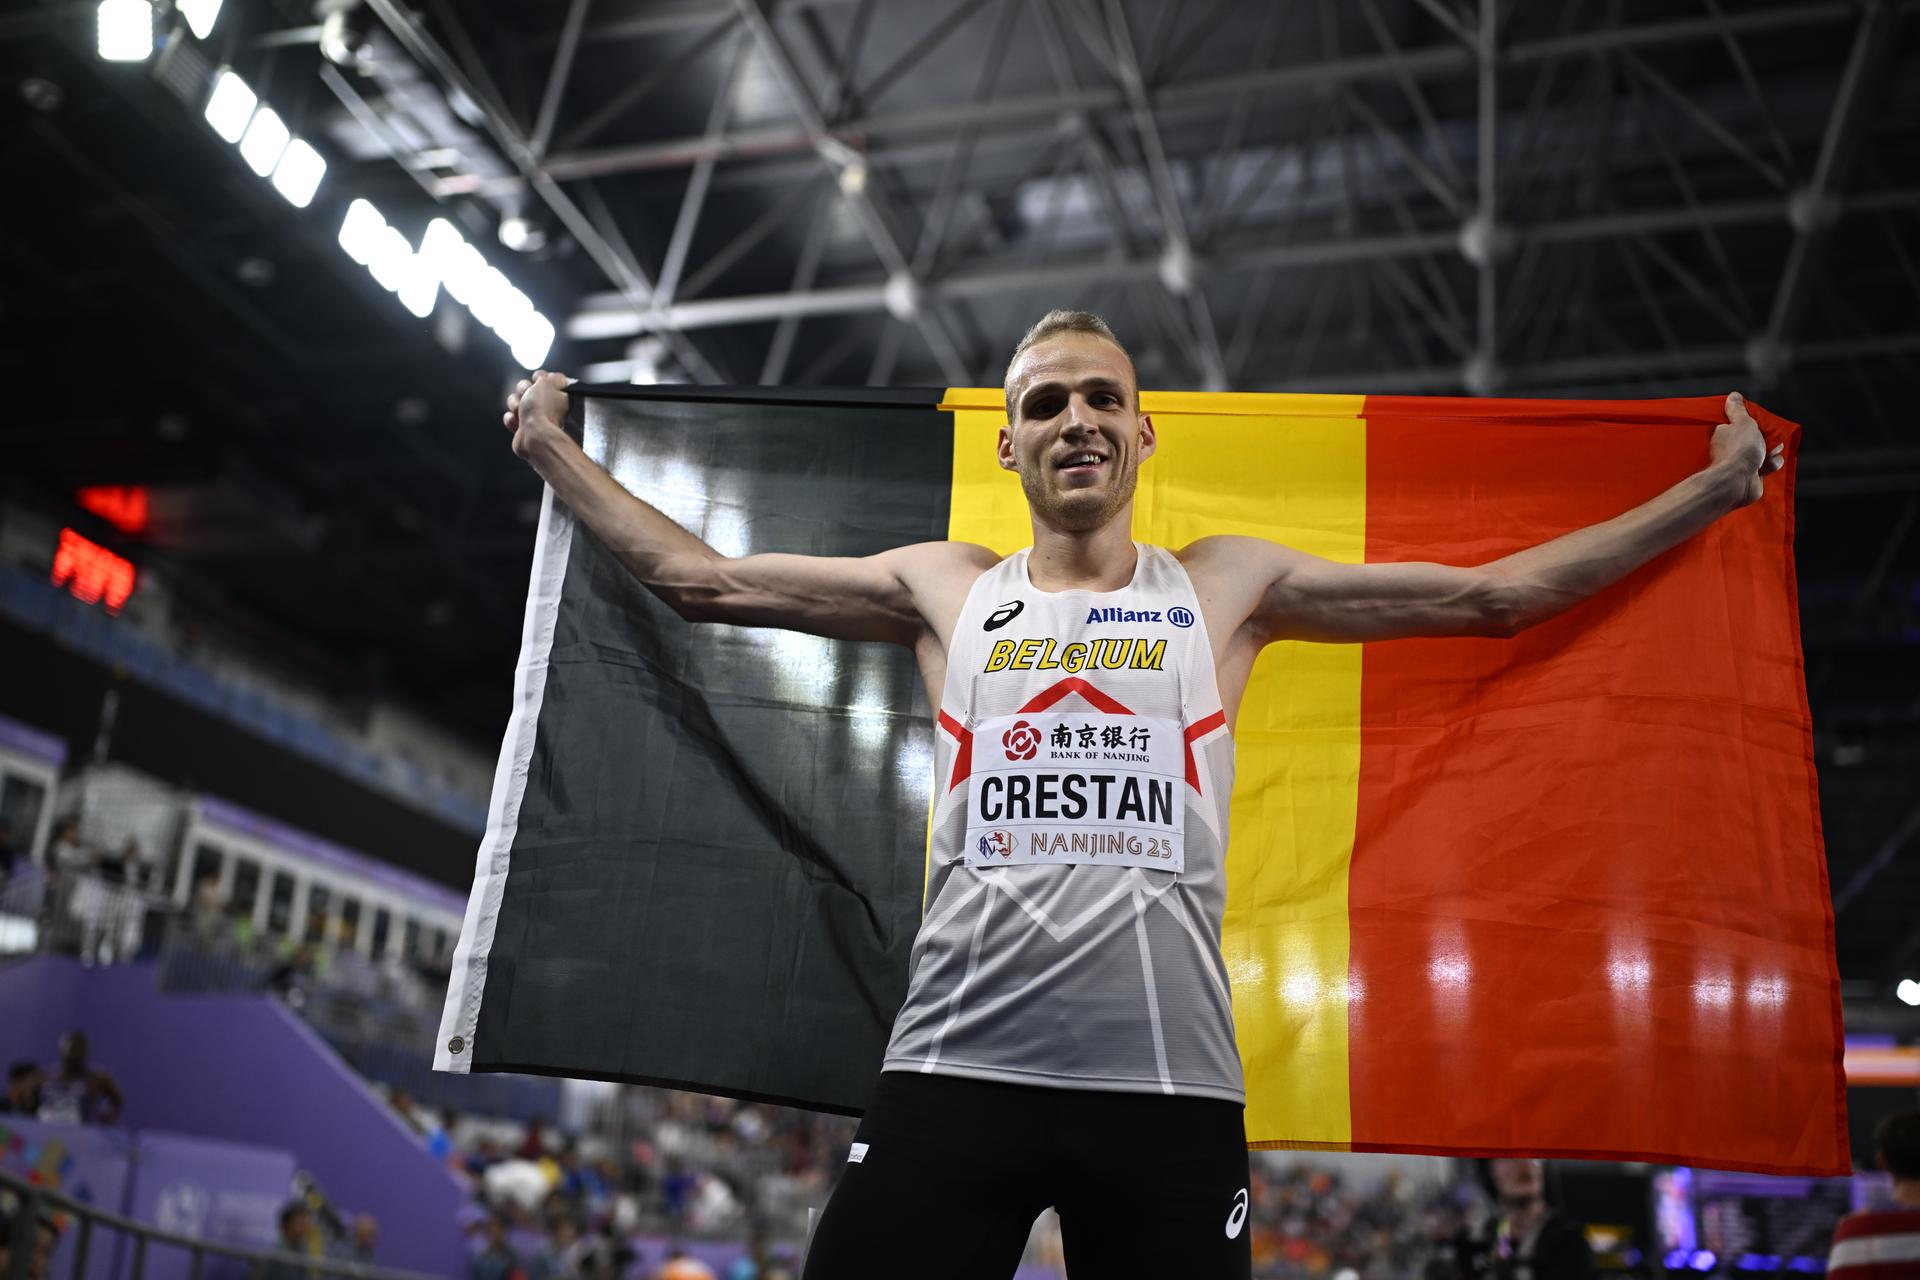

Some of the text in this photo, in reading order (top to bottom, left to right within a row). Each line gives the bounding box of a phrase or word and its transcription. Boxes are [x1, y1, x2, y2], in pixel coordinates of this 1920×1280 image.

[1086, 607, 1163, 624] Allianz
[984, 638, 1168, 673] BELGIUM
[1050, 722, 1151, 752] 南京银行
[1050, 751, 1150, 763] BANK OF NANJING
[980, 774, 1173, 825] CRESTAN
[1030, 831, 1172, 858] NANJING 25
